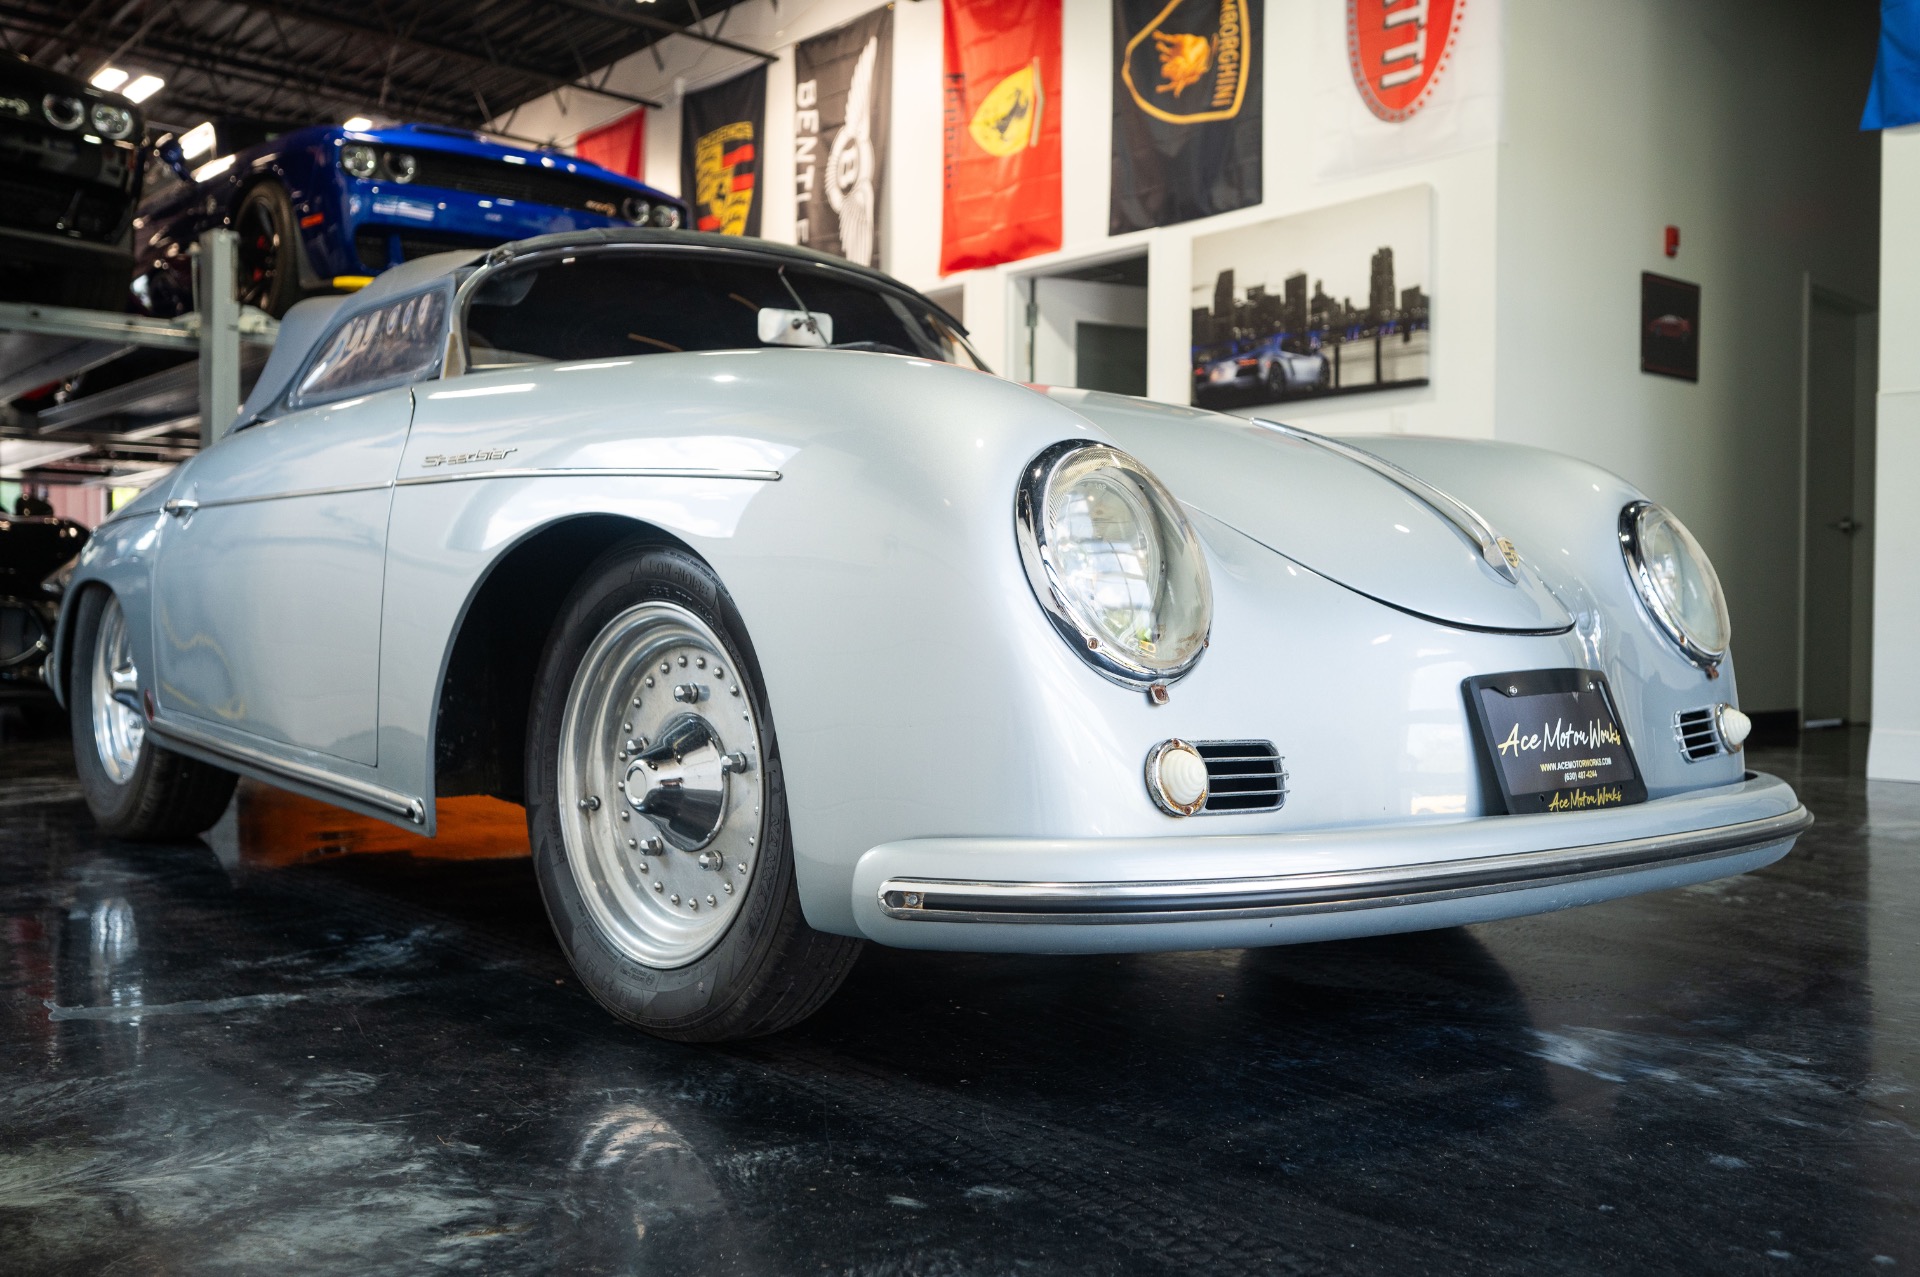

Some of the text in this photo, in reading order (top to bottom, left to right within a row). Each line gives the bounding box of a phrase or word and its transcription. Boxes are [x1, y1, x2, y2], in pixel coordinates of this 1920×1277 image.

[1380, 0, 1430, 91] TTI
[421, 447, 518, 468] Speedster
[1498, 717, 1621, 757] Ace Motor Works
[1540, 757, 1612, 772] WWW.ACEMOTORWORKS.COM
[1564, 771, 1577, 783] (630)
[1548, 786, 1622, 812] Ace Motor Works
